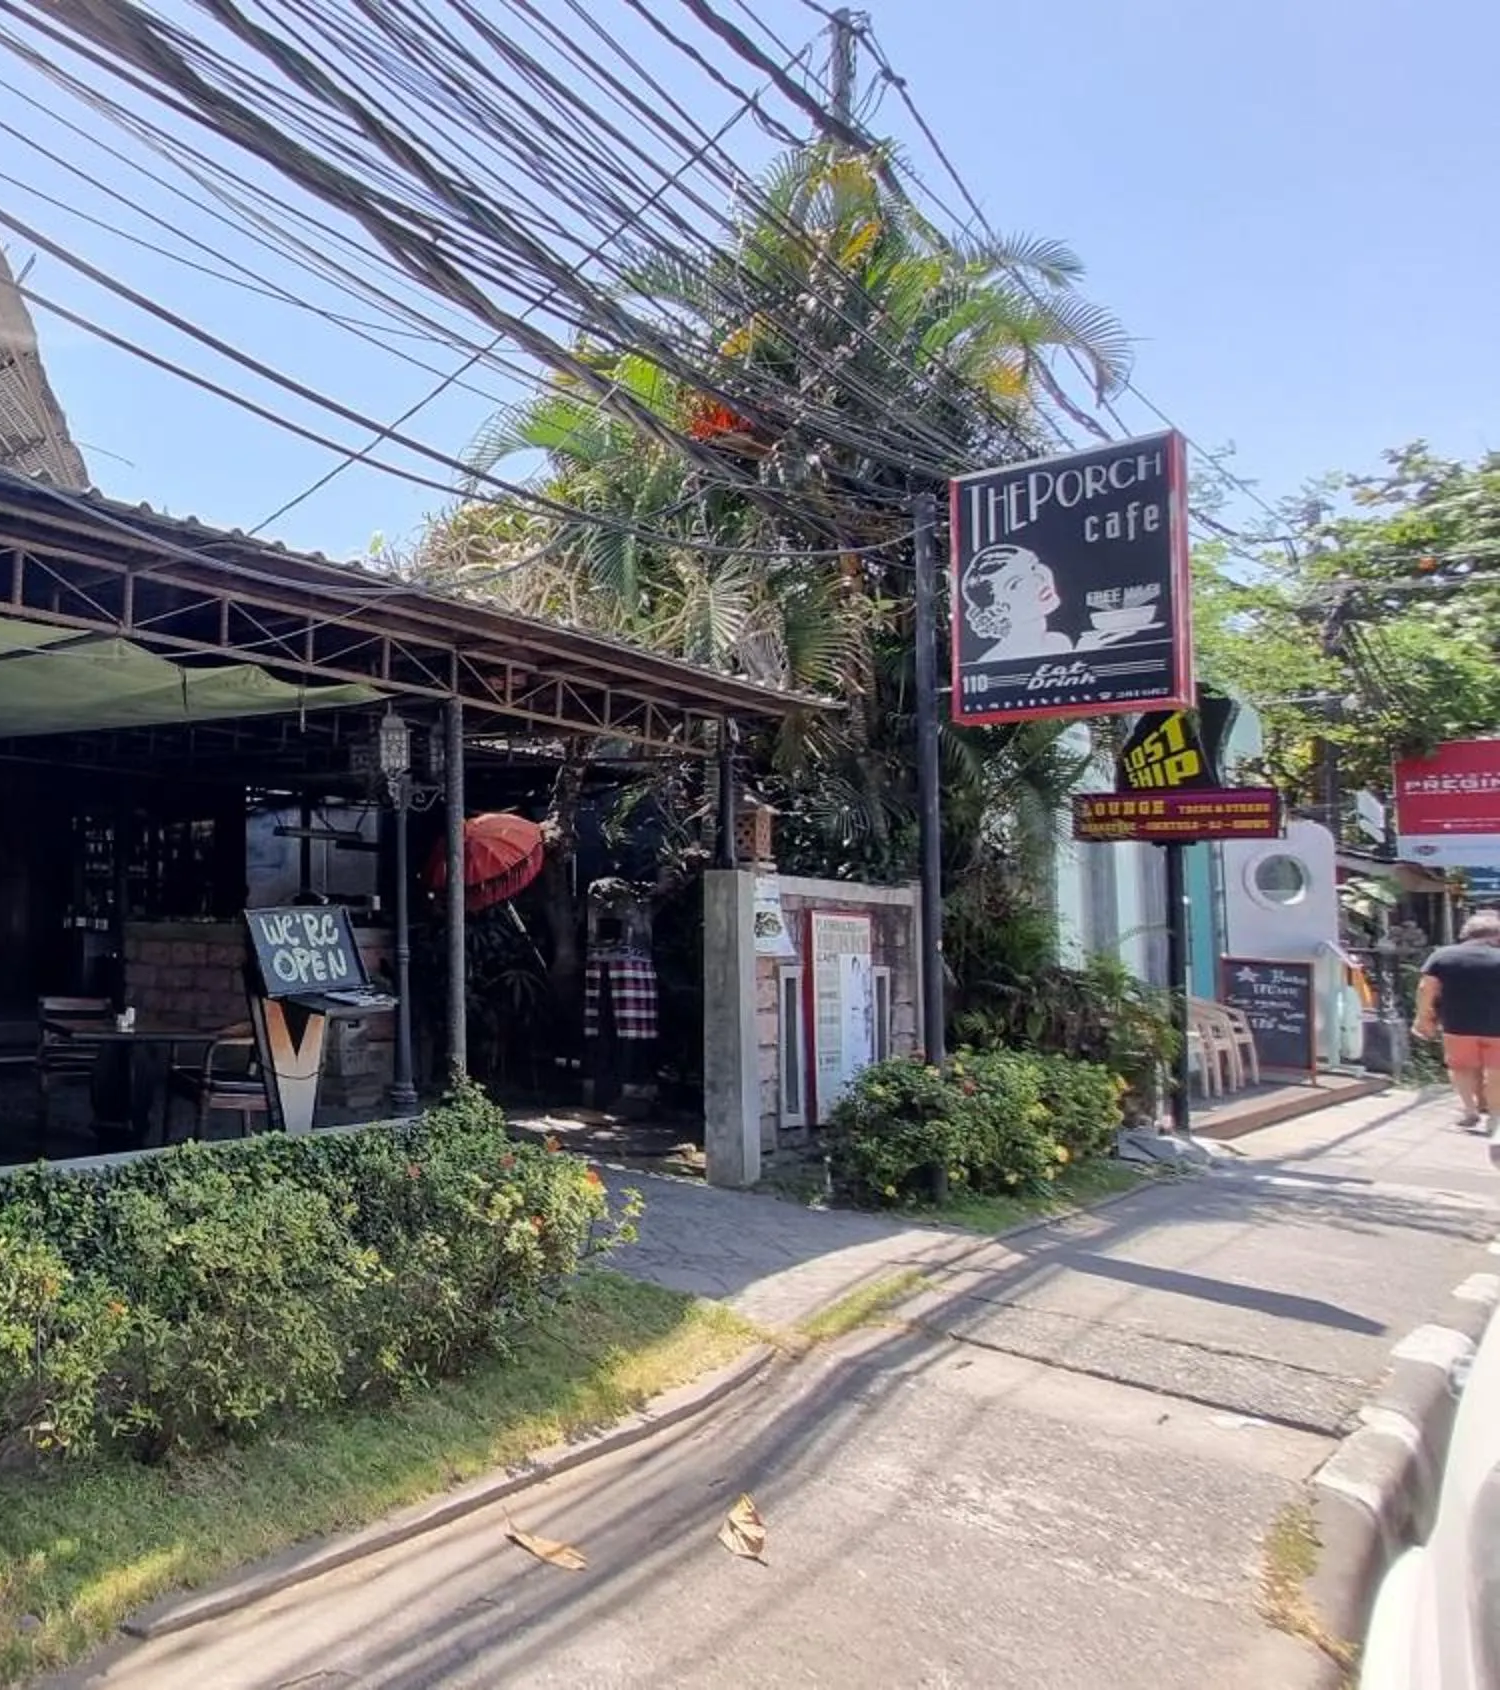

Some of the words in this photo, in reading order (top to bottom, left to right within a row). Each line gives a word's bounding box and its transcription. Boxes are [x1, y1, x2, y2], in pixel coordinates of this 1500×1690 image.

[964, 482, 1026, 552] THE
[1028, 451, 1163, 523] PORCH
[1084, 501, 1160, 543] cafe
[962, 674, 989, 694] 110
[1027, 672, 1098, 691] Drink
[1036, 660, 1089, 678] Eat
[1124, 709, 1187, 773] LOST
[1129, 749, 1201, 789] SHIP
[273, 947, 348, 984] OPEN
